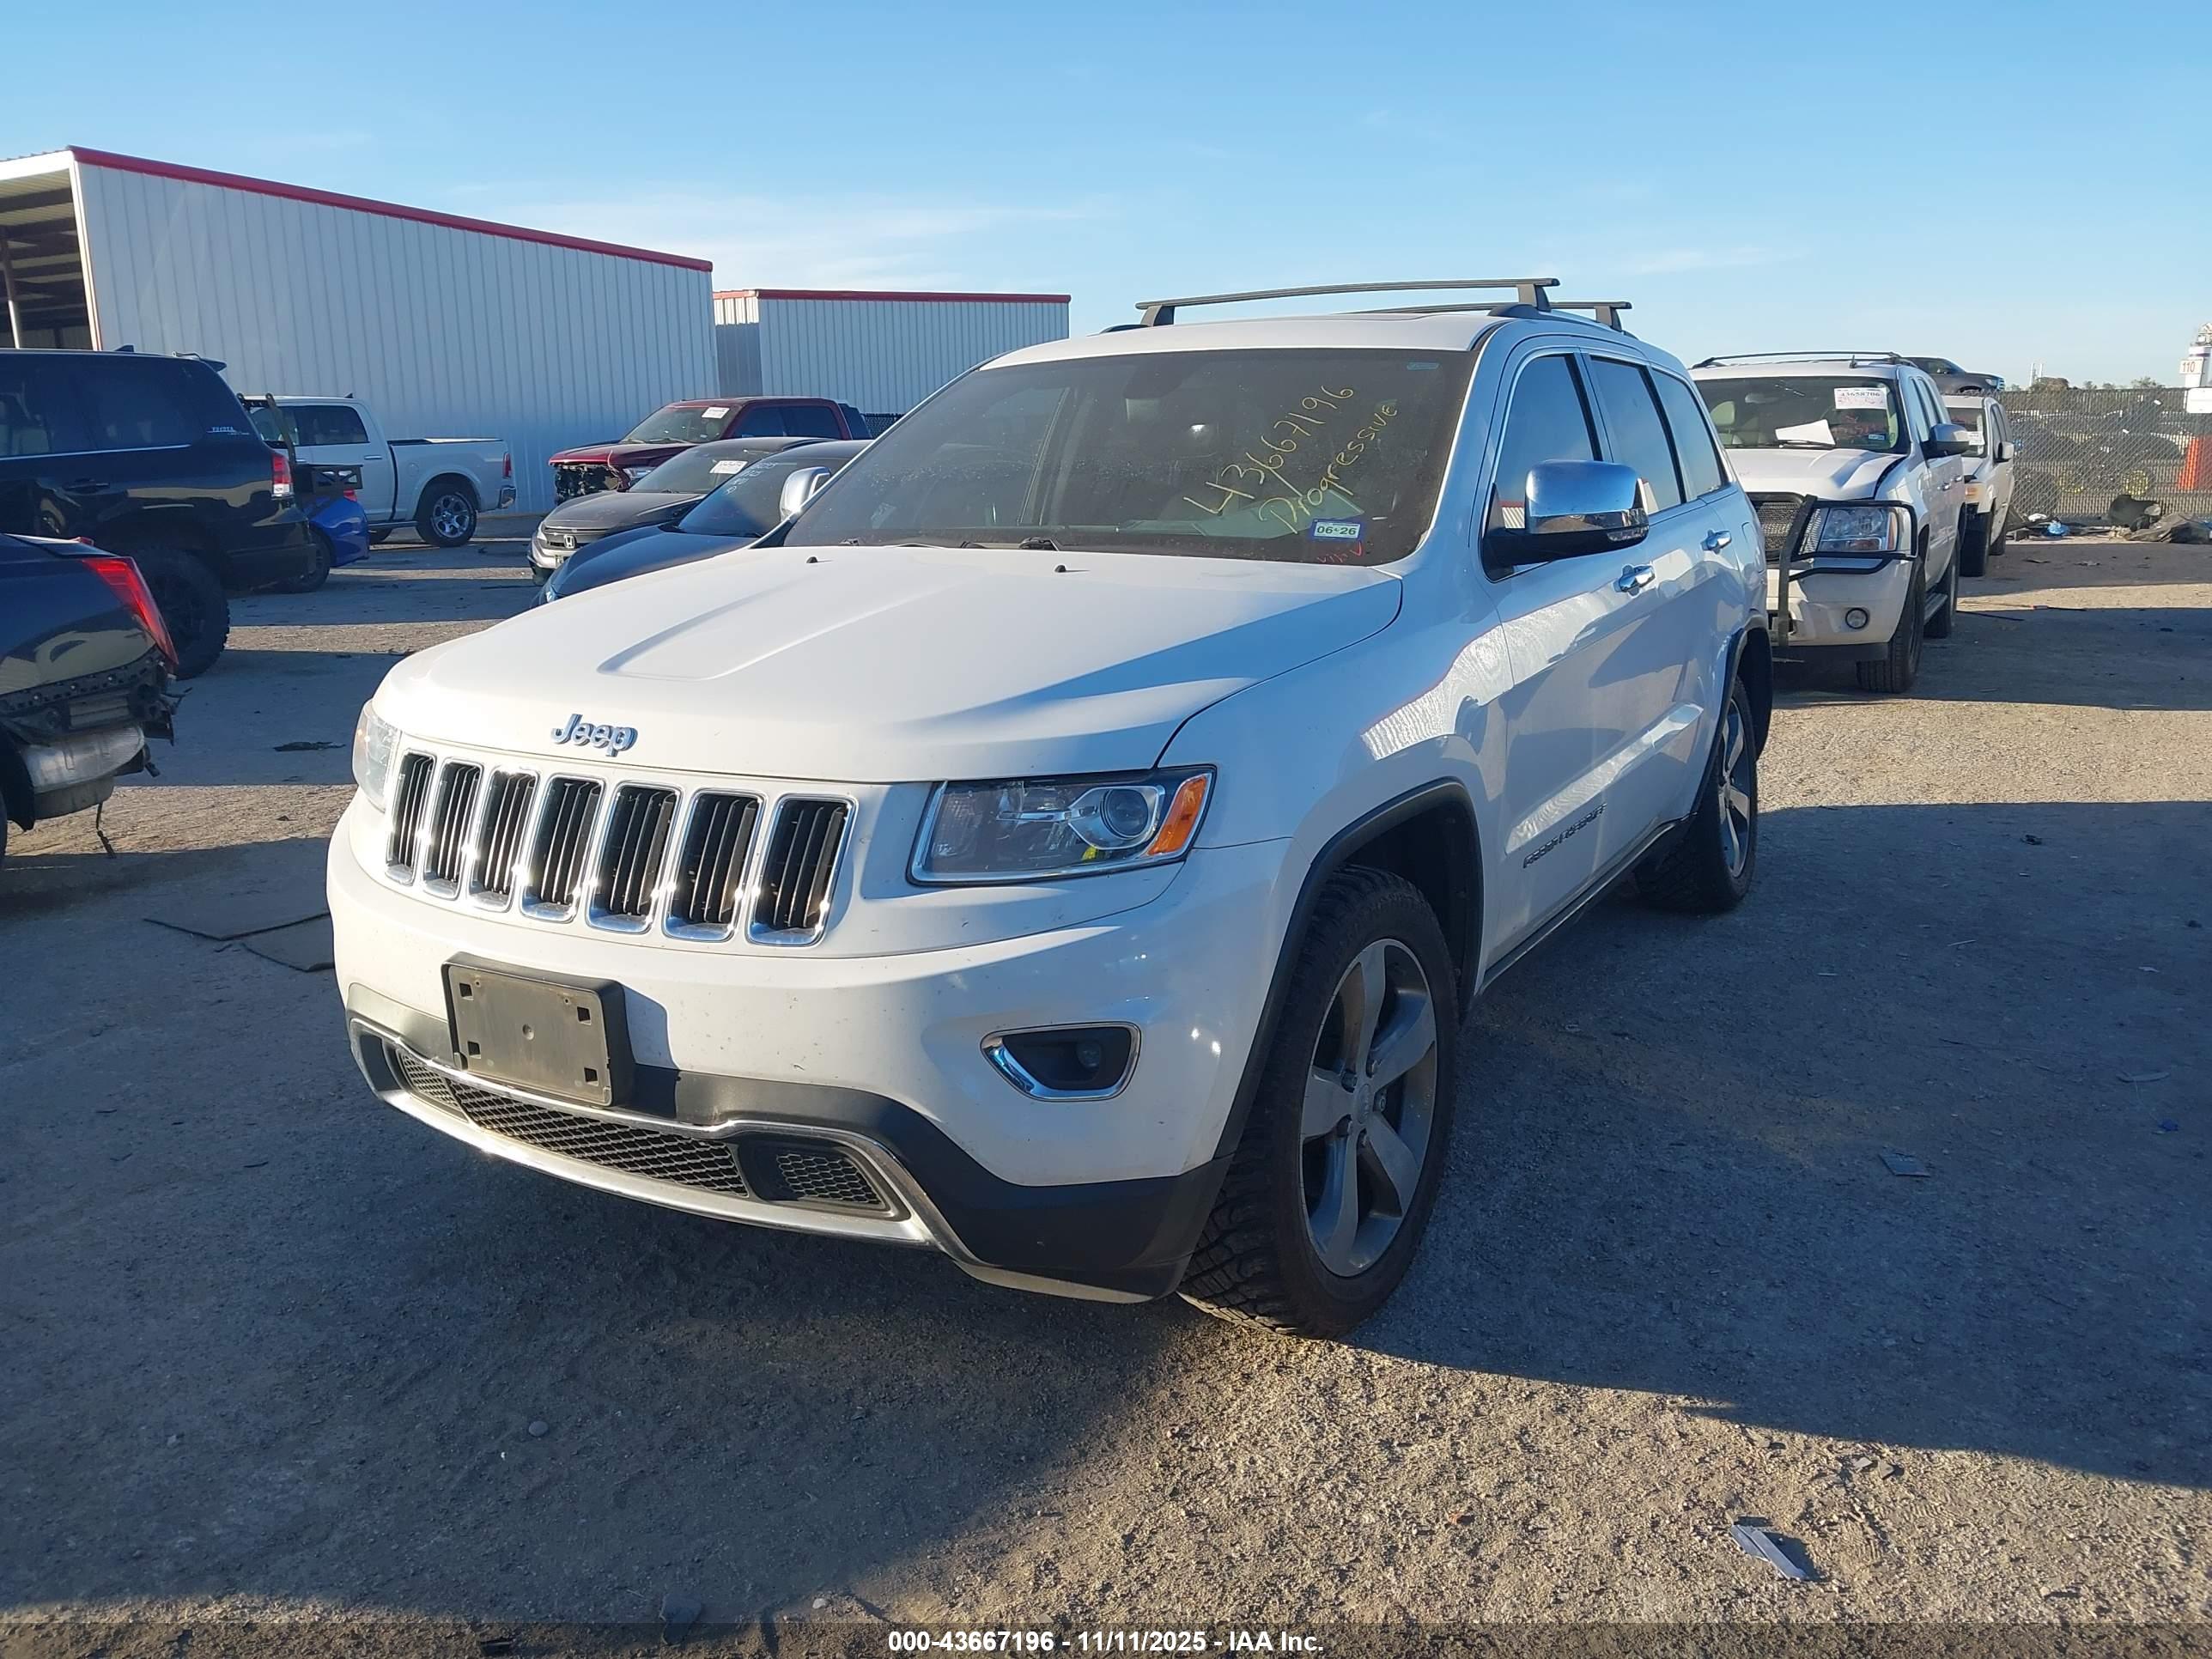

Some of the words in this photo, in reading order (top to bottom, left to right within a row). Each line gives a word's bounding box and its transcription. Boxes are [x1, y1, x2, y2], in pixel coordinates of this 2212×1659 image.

[2182, 361, 2196, 373] 110
[1183, 385, 1354, 514] 43667196
[550, 713, 638, 757] Jeep
